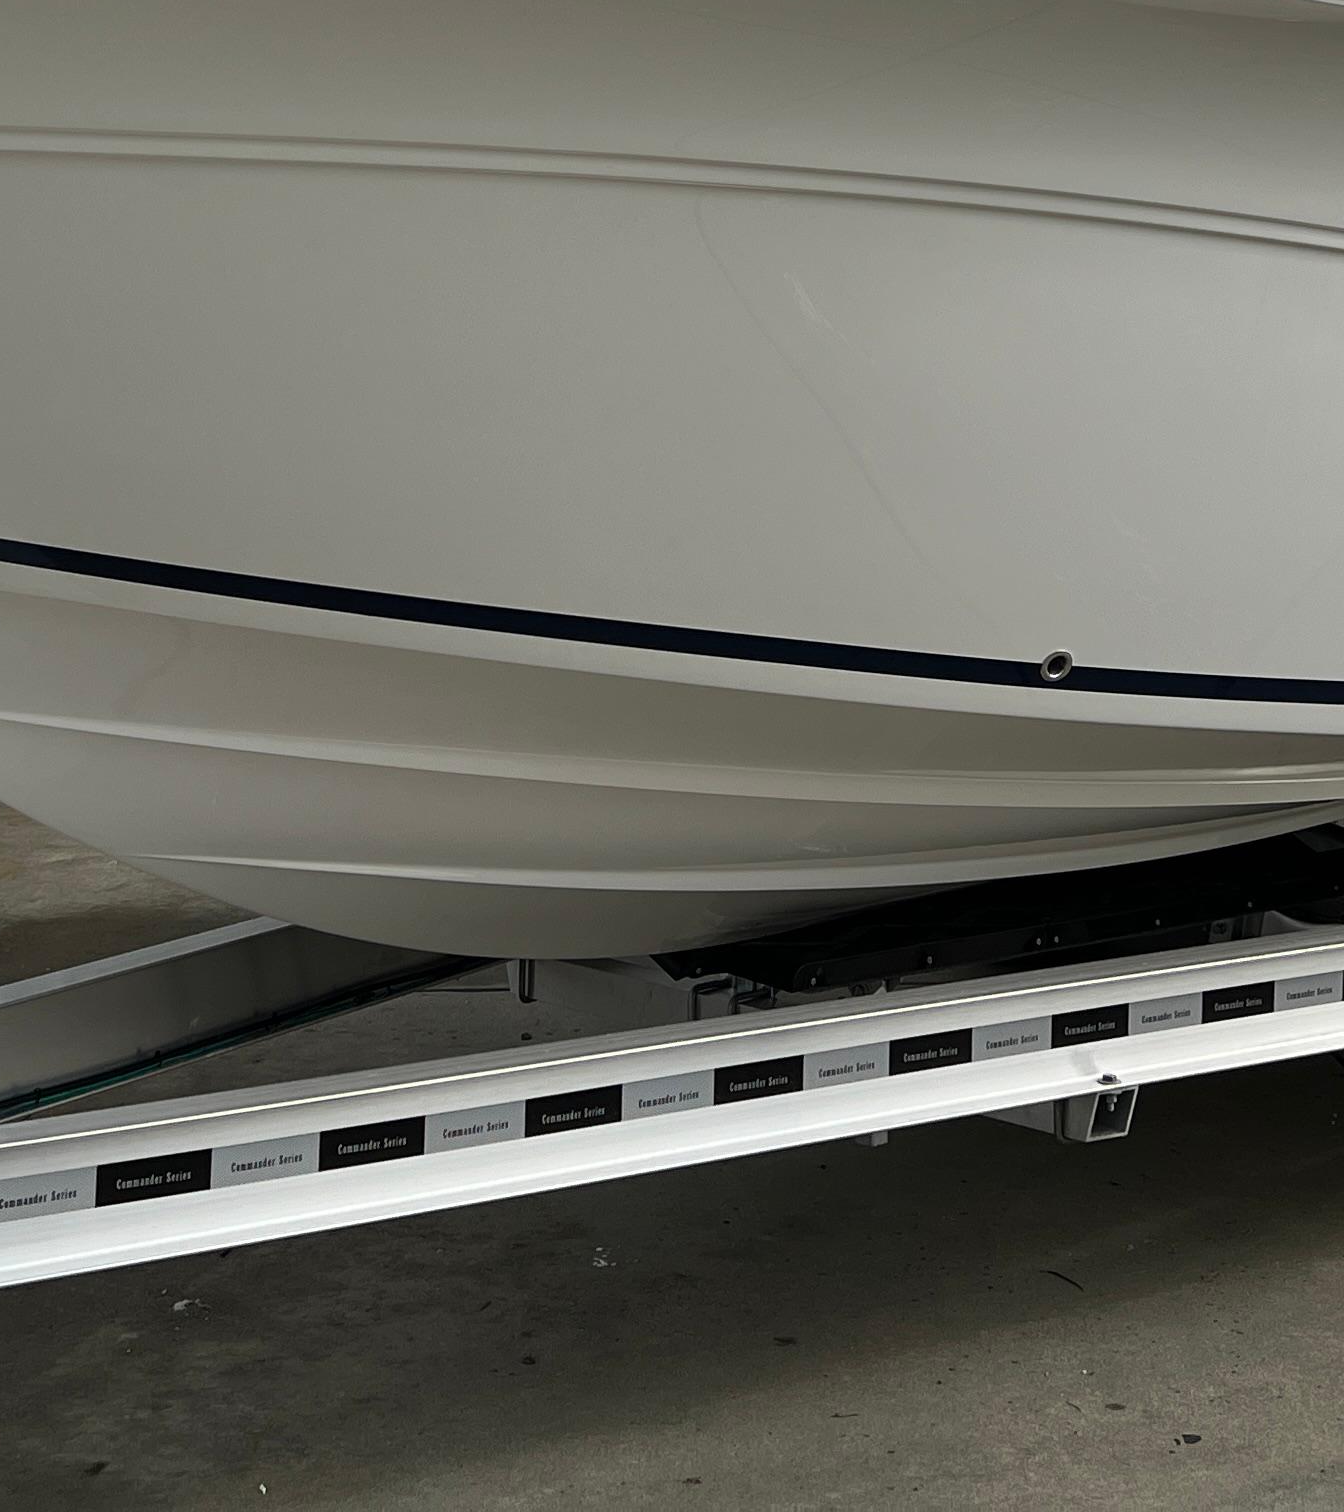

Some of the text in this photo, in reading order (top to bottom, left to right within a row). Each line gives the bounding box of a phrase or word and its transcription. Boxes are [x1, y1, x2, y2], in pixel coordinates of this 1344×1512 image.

[818, 1062, 875, 1078] Commander Series
[729, 1075, 788, 1092] Commander Series
[638, 1090, 699, 1108] Commander Series
[542, 1106, 606, 1125] Commander Series
[442, 1121, 509, 1138] Commander Series
[337, 1137, 407, 1155] Commander Series
[231, 1154, 303, 1173] Commander Series
[116, 1171, 192, 1190] Commander Series
[50, 1189, 77, 1201] Series
